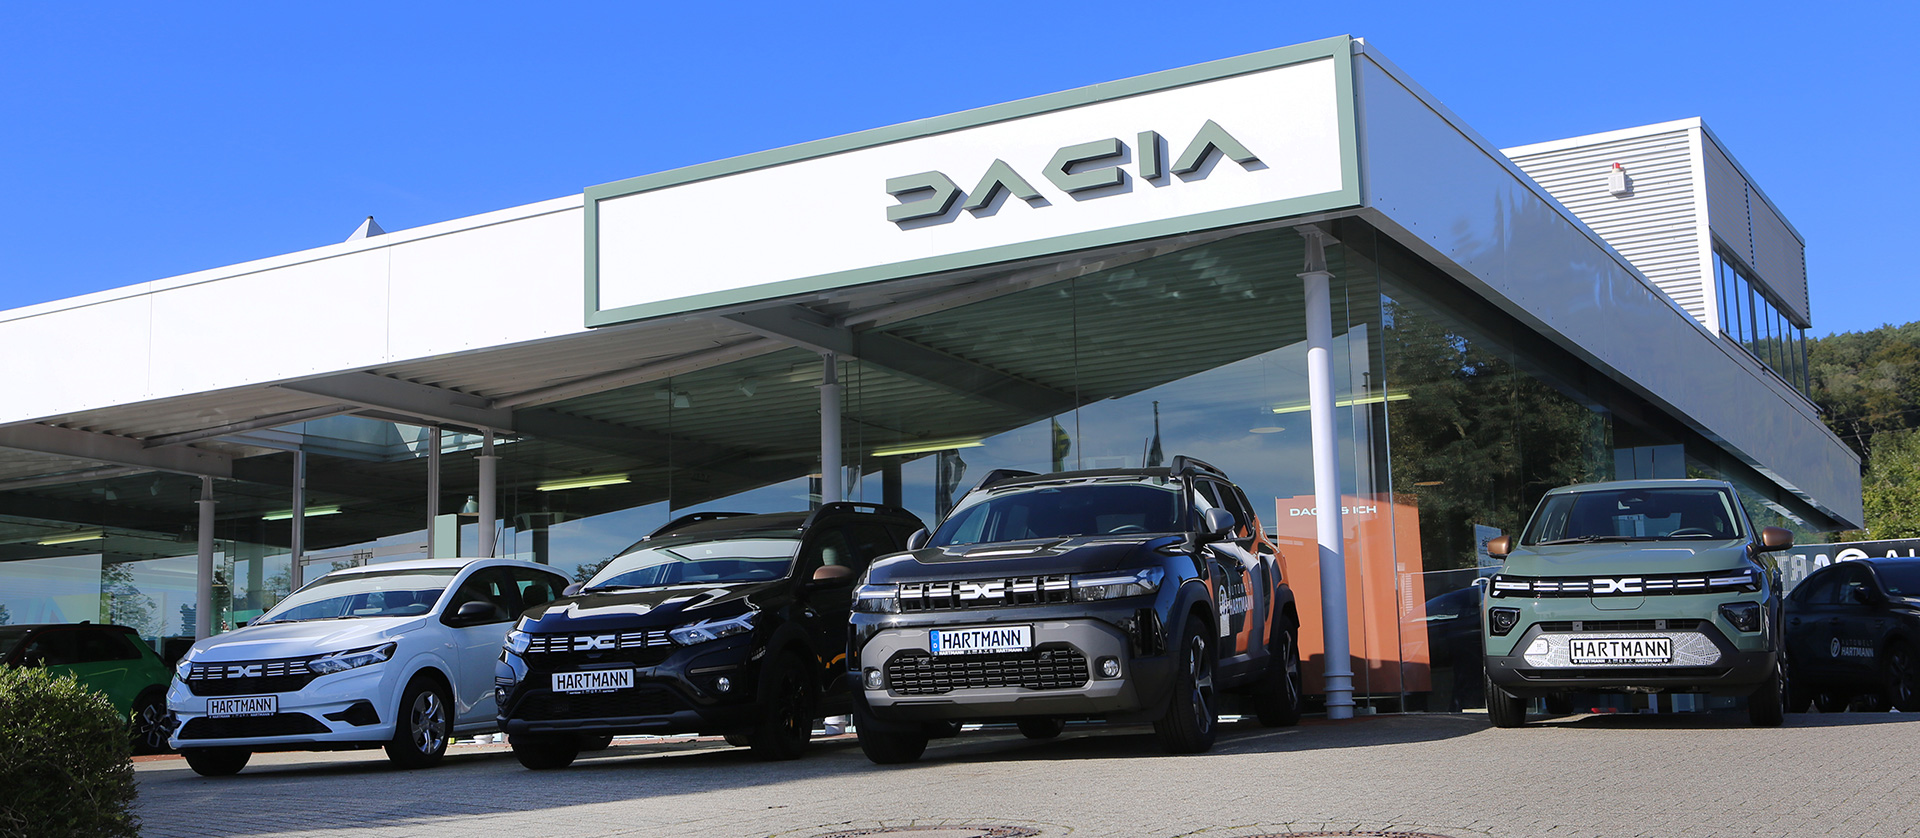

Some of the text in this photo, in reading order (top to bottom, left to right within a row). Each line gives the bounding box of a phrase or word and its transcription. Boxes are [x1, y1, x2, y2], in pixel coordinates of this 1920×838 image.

[886, 119, 1260, 224] DACIA
[1289, 508, 1318, 517] DAC
[1353, 505, 1377, 514] ICH
[942, 629, 1021, 649] HARTMANN
[1573, 641, 1668, 657] HARTMANN
[1841, 646, 1874, 657] HARTMANN
[557, 671, 628, 690] HARTMANN
[211, 698, 272, 714] HARTMANN
